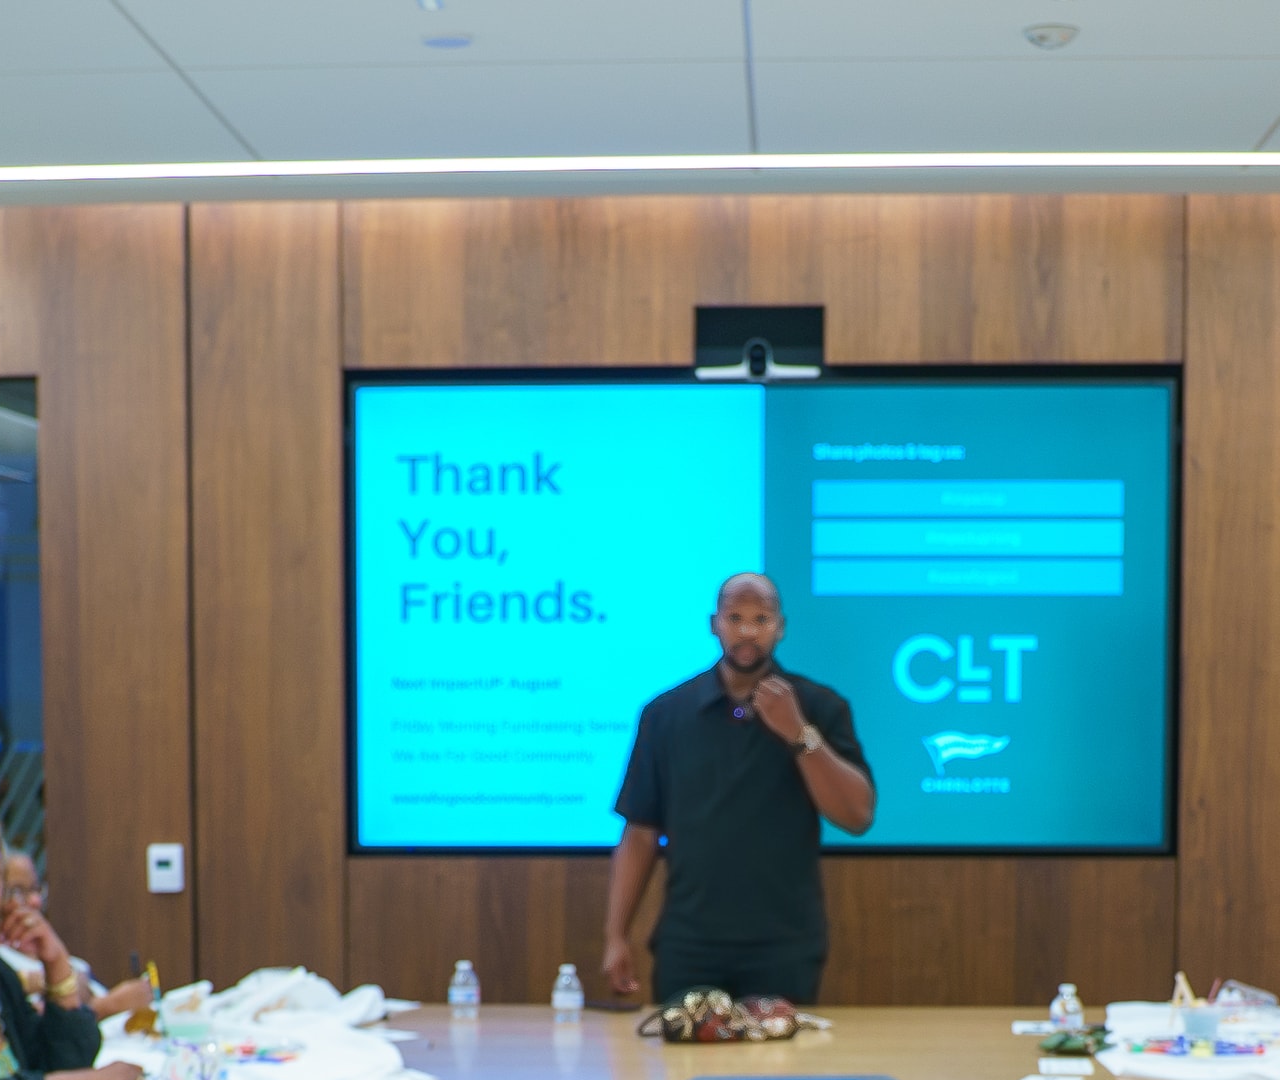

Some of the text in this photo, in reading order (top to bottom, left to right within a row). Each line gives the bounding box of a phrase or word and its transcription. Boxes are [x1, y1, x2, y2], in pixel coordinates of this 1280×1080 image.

[396, 452, 562, 495] Thank
[397, 518, 509, 566] You,
[400, 580, 608, 624] Friends.
[892, 633, 1039, 704] CLT
[921, 777, 1011, 793] CHARLOTTE
